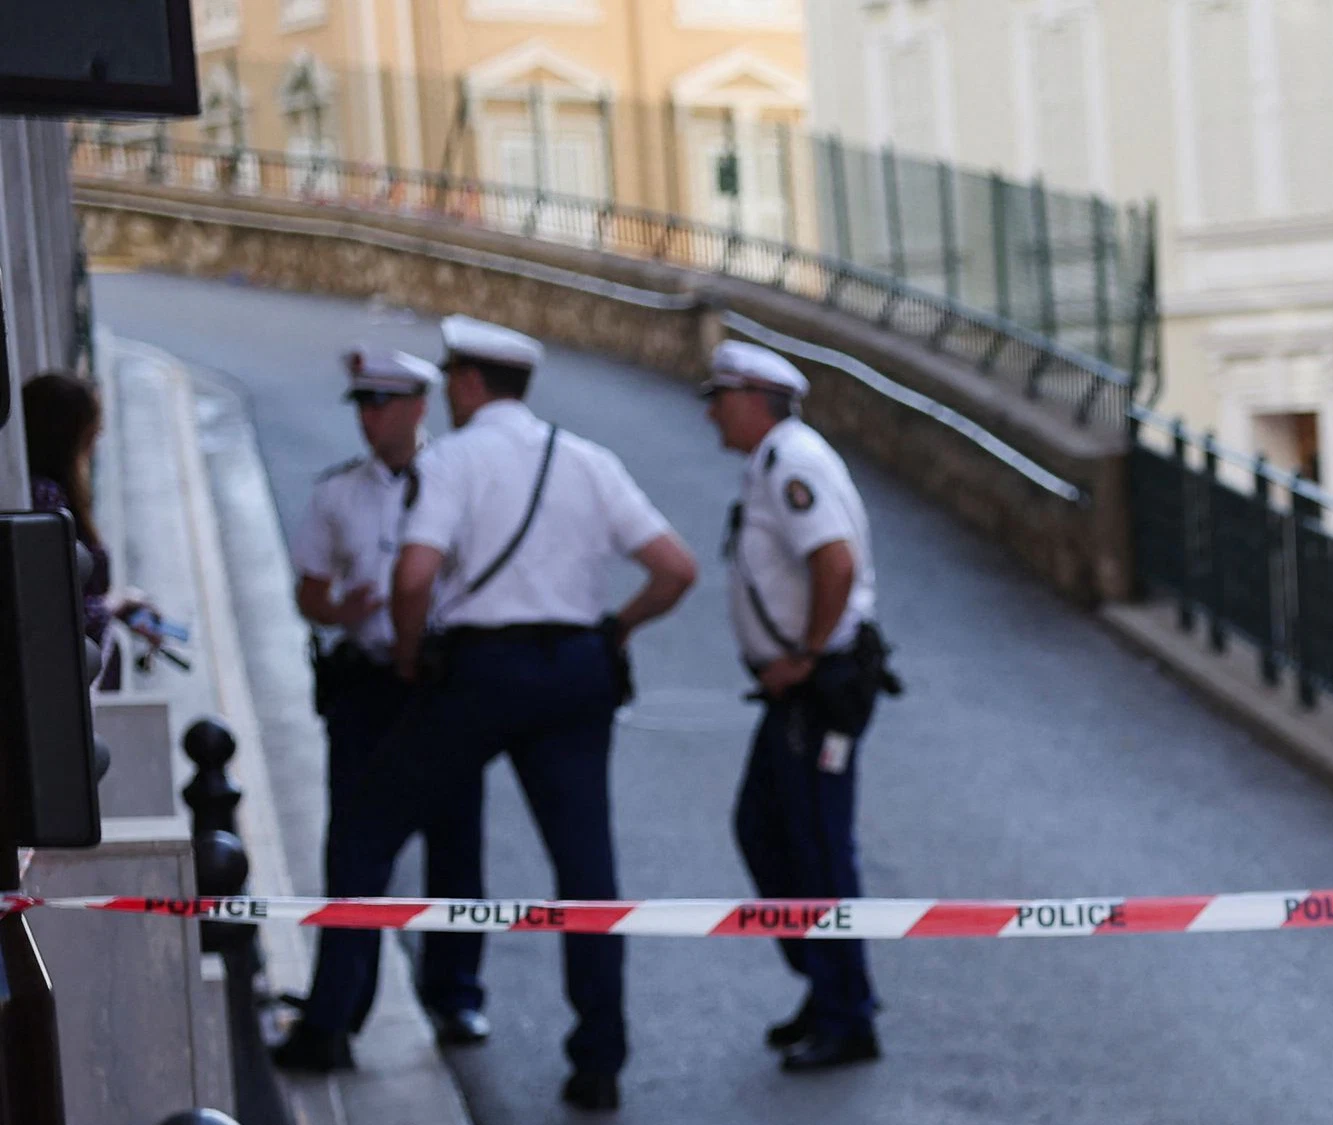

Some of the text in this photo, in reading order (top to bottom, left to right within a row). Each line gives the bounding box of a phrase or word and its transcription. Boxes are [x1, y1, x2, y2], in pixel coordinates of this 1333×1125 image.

[144, 898, 267, 918] POLICE
[448, 902, 564, 925] POLICE
[738, 903, 852, 929] POLICE
[1016, 904, 1126, 928] POLICE
